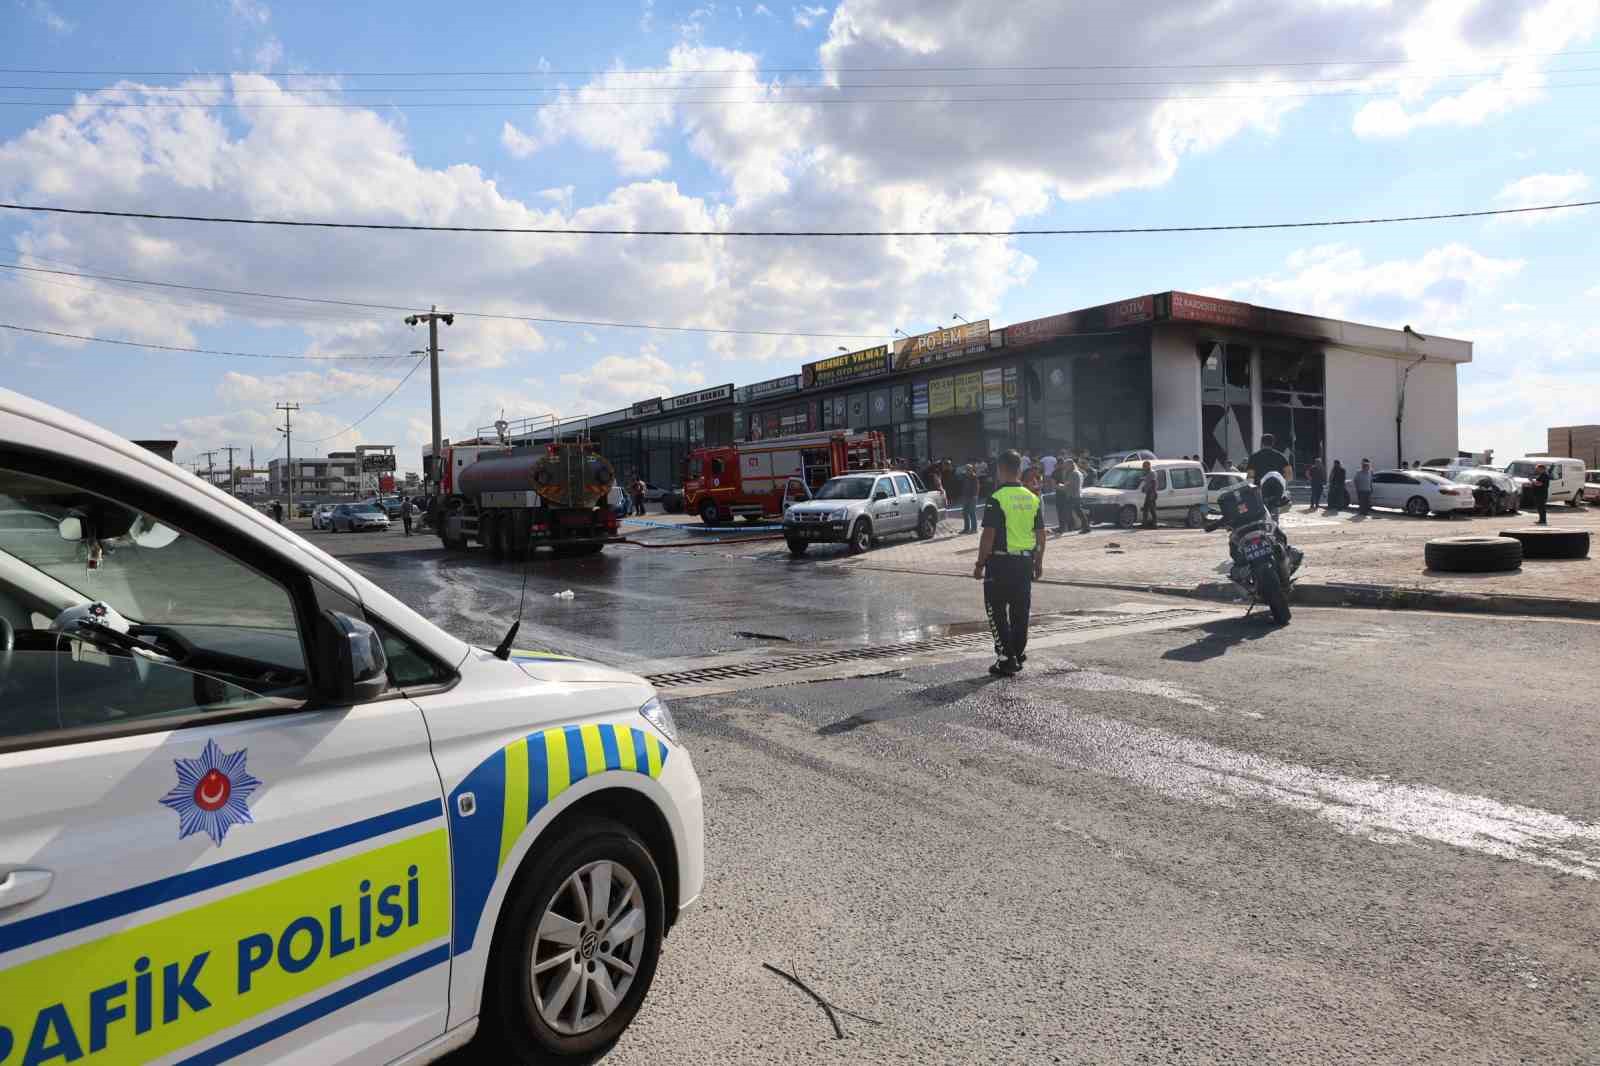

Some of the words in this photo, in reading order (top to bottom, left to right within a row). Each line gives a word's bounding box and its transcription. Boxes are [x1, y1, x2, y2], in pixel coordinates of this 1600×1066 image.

[918, 328, 961, 352] PO-EM
[852, 347, 885, 363] YILMAZ
[0, 951, 212, 1066] AFİK
[237, 864, 419, 995] POLİSİ
